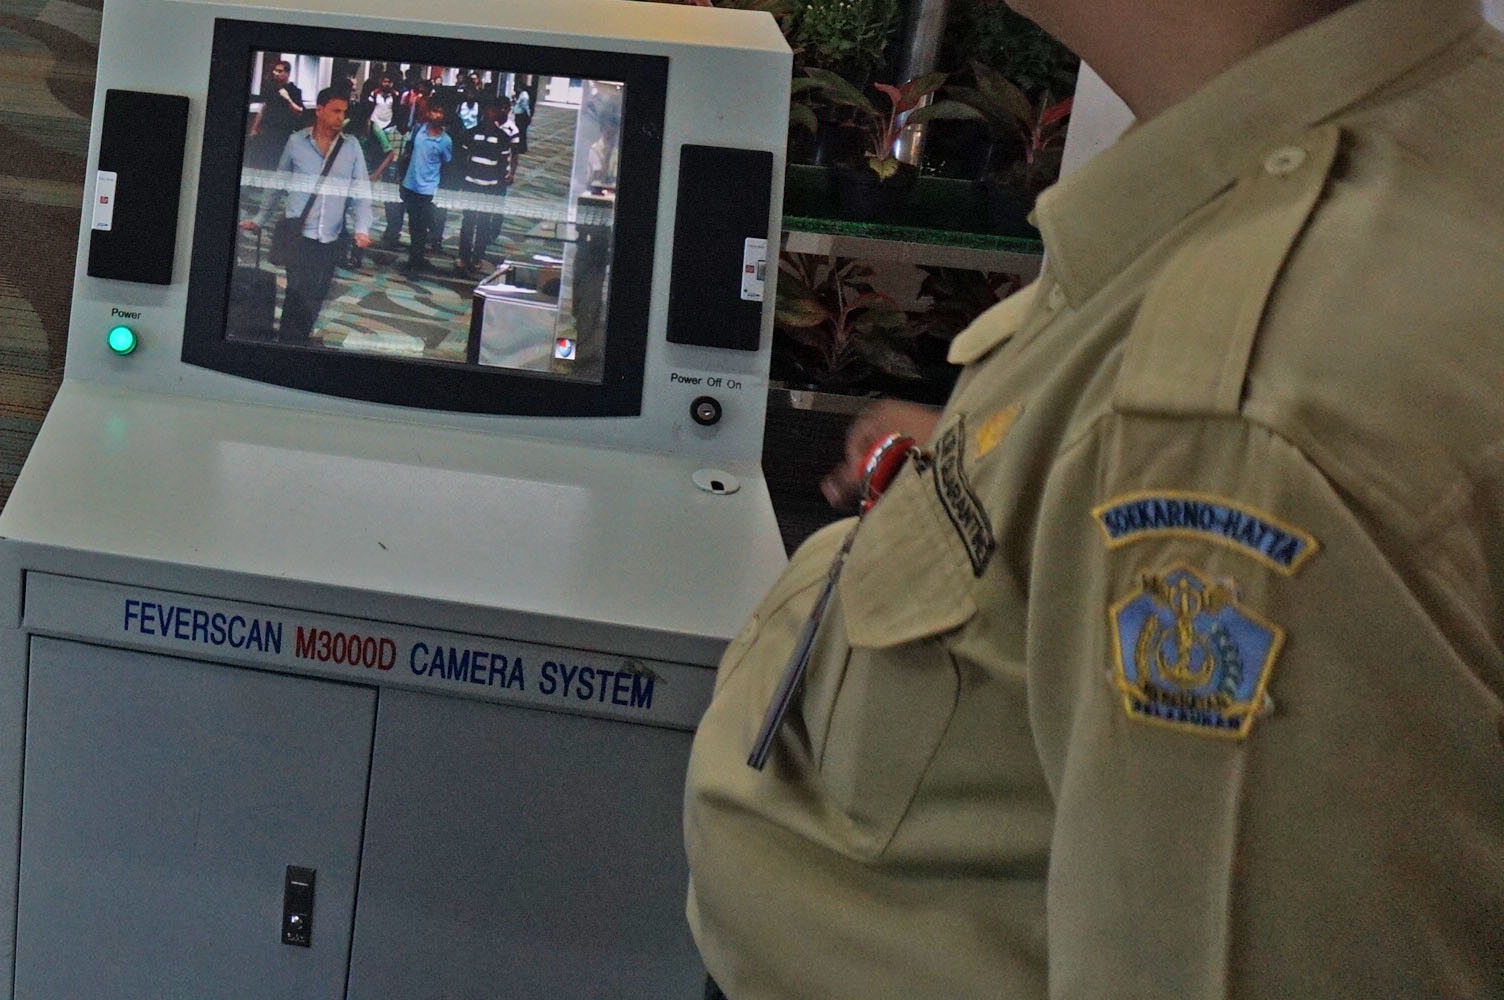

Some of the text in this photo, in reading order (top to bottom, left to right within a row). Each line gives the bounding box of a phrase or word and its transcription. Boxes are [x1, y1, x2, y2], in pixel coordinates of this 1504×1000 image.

[111, 308, 141, 320] Power
[670, 372, 742, 389] Power Off On
[1103, 497, 1300, 566] SOEKARNO-HATTA
[123, 598, 656, 710] FEVERSCAN M3000D CAMERA SYSTEM
